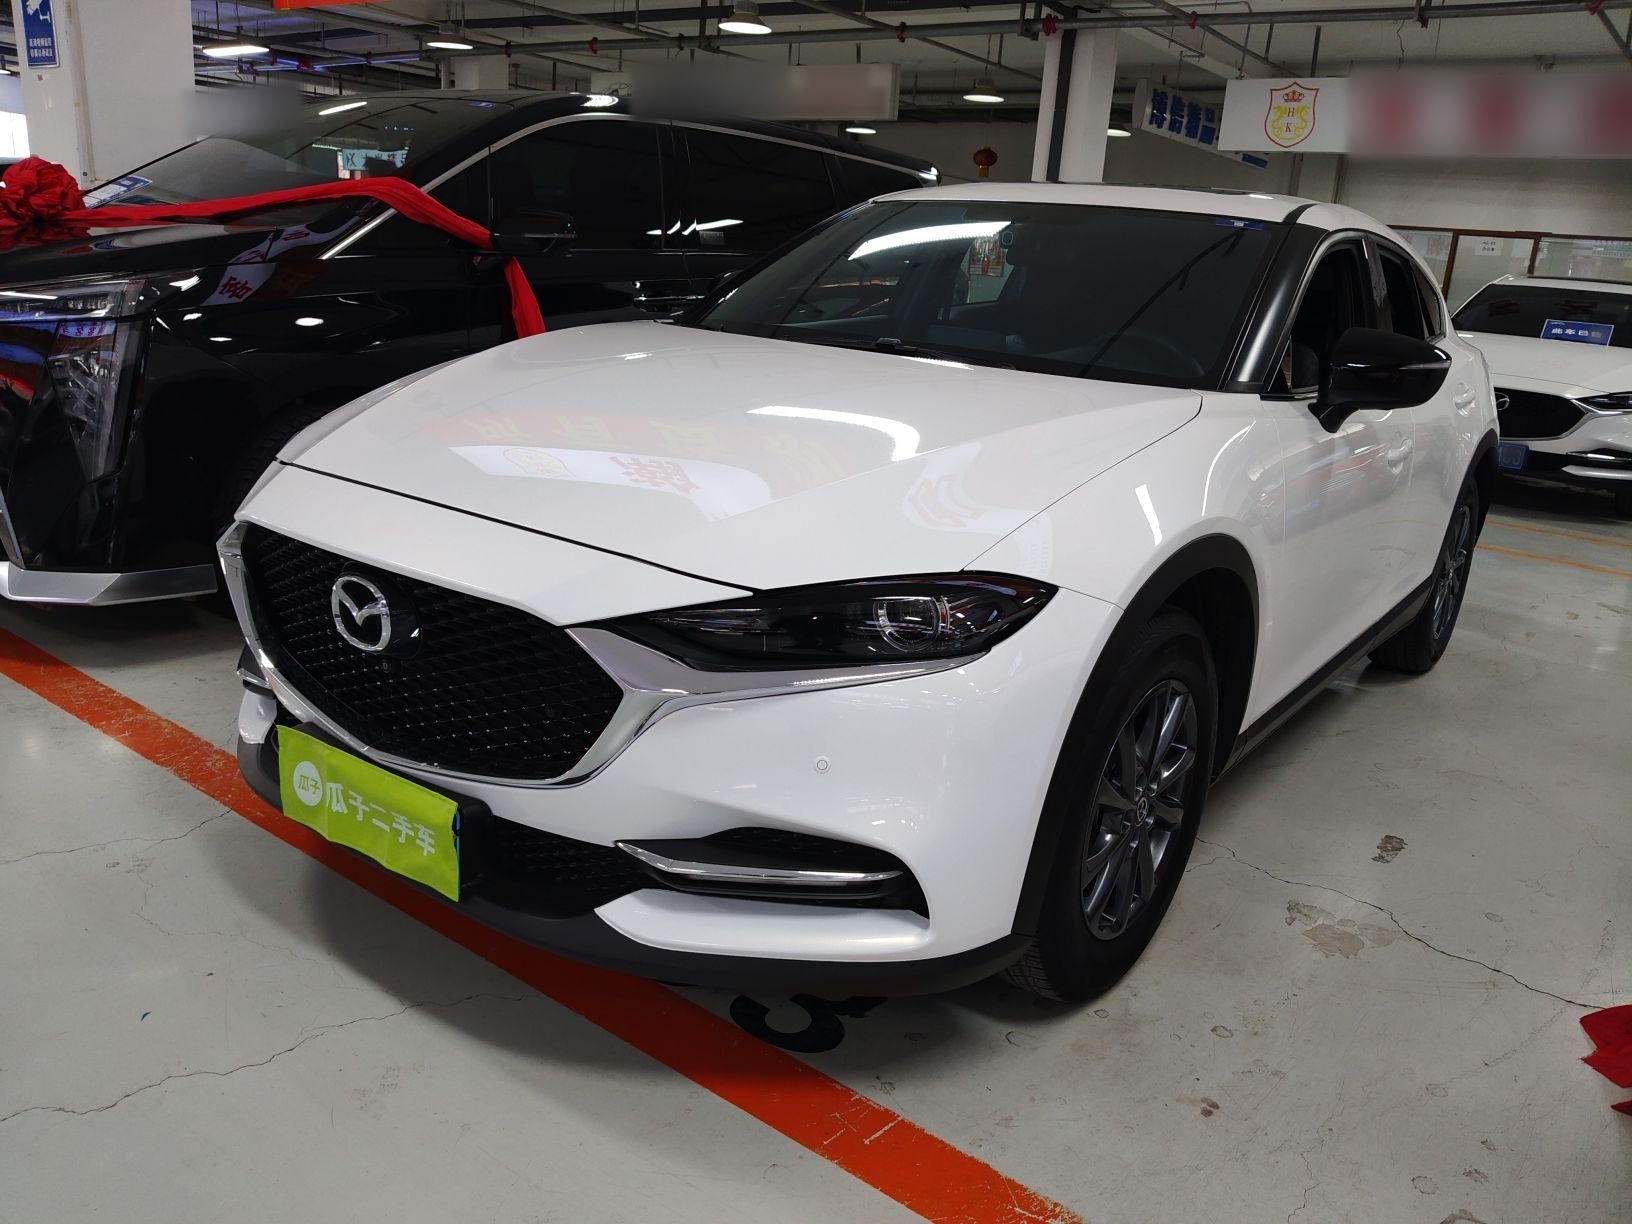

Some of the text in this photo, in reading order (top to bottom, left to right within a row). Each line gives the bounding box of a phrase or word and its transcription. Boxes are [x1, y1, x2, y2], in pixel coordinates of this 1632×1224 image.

[1287, 107, 1295, 117] H
[1285, 122, 1292, 133] K
[298, 774, 321, 795] 瓜子
[326, 782, 436, 857] 瓜子二手车
